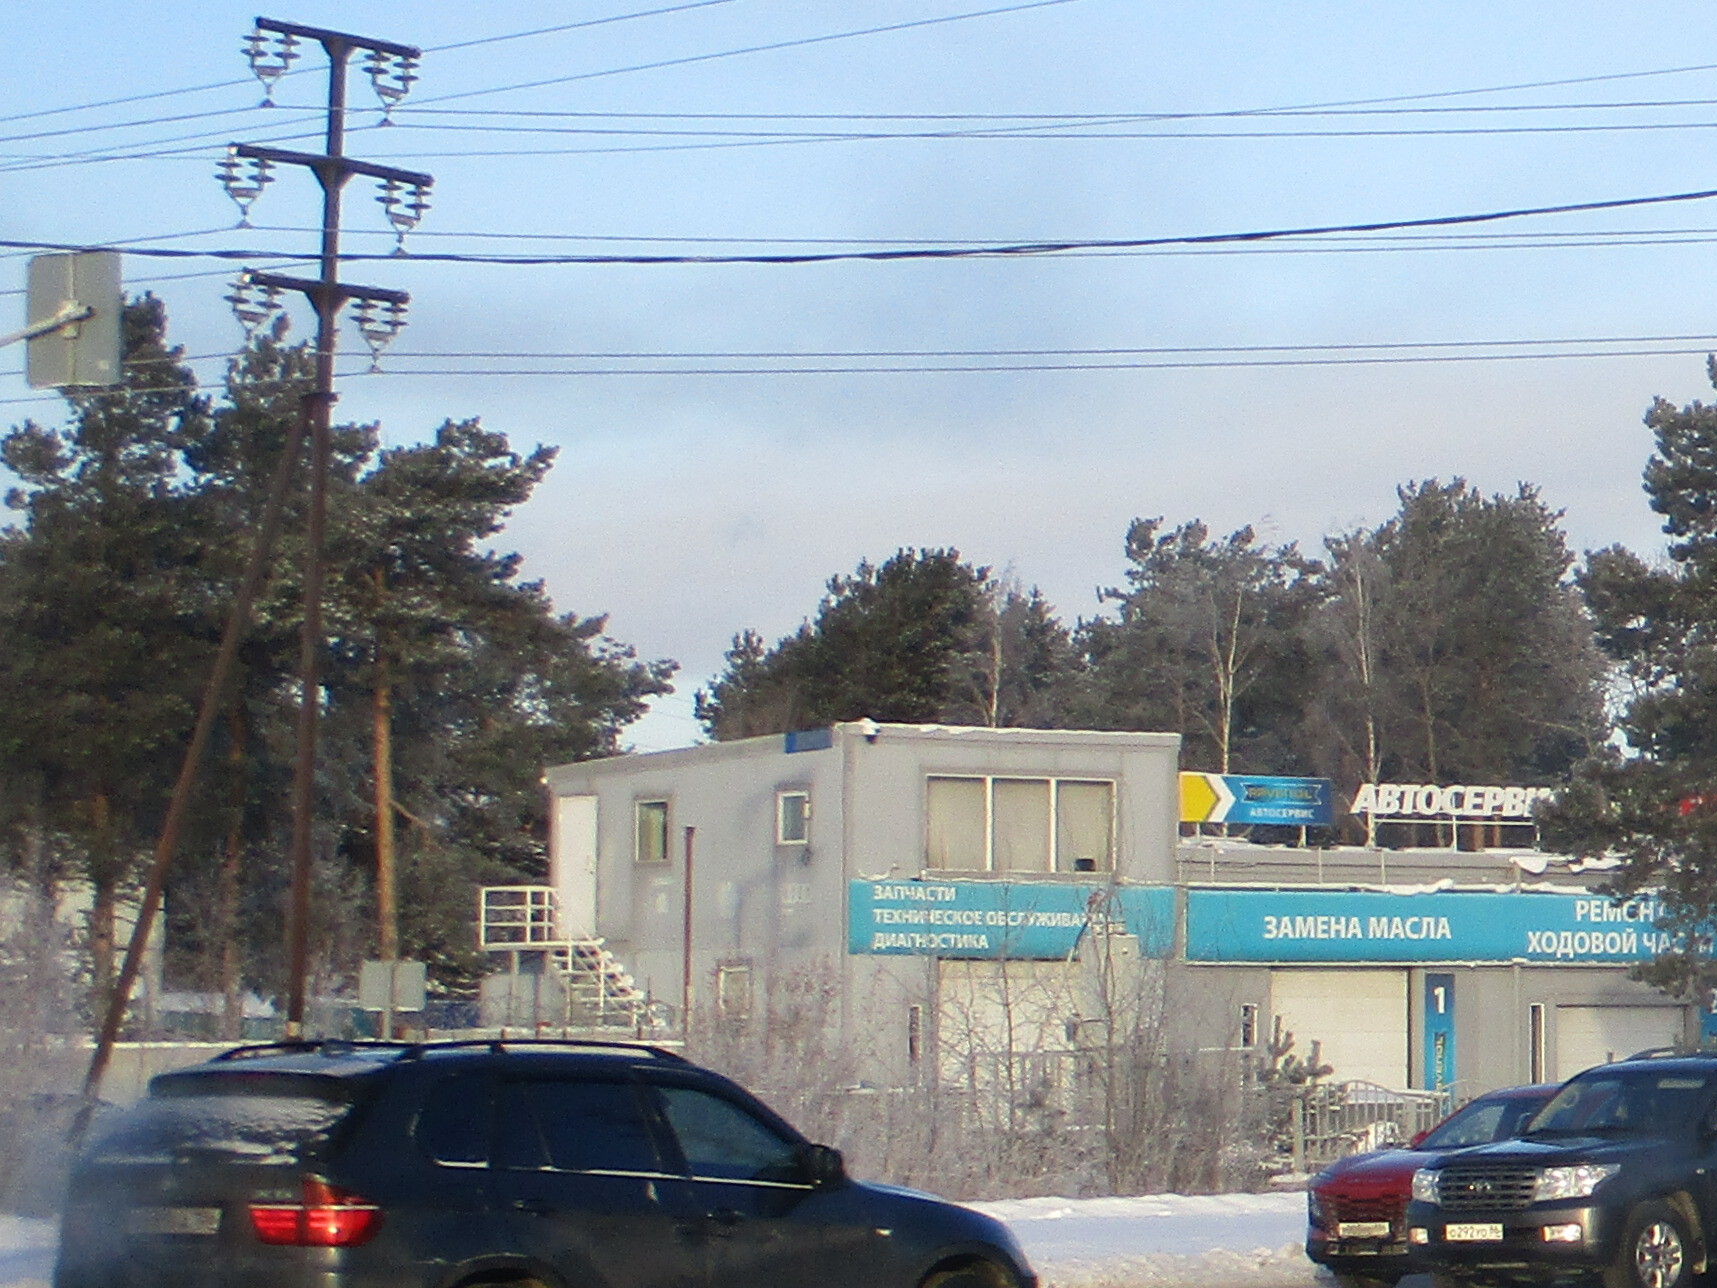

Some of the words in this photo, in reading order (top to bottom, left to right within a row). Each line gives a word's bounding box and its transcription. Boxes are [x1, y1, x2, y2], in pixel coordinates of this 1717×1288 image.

[1249, 807, 1315, 819] АВТОСЕРВИС
[872, 885, 956, 902] ЗАПЧАСТИ
[873, 909, 982, 925] ТЕХНИЧЕСКОЕ
[1263, 916, 1362, 939] ЗАМЕНА
[1369, 917, 1452, 940] МАСЛА
[872, 932, 988, 950] ДИАГНОСТИКА
[1527, 928, 1637, 959] ХОДОВОЙ
[1433, 986, 1446, 1015] 1
